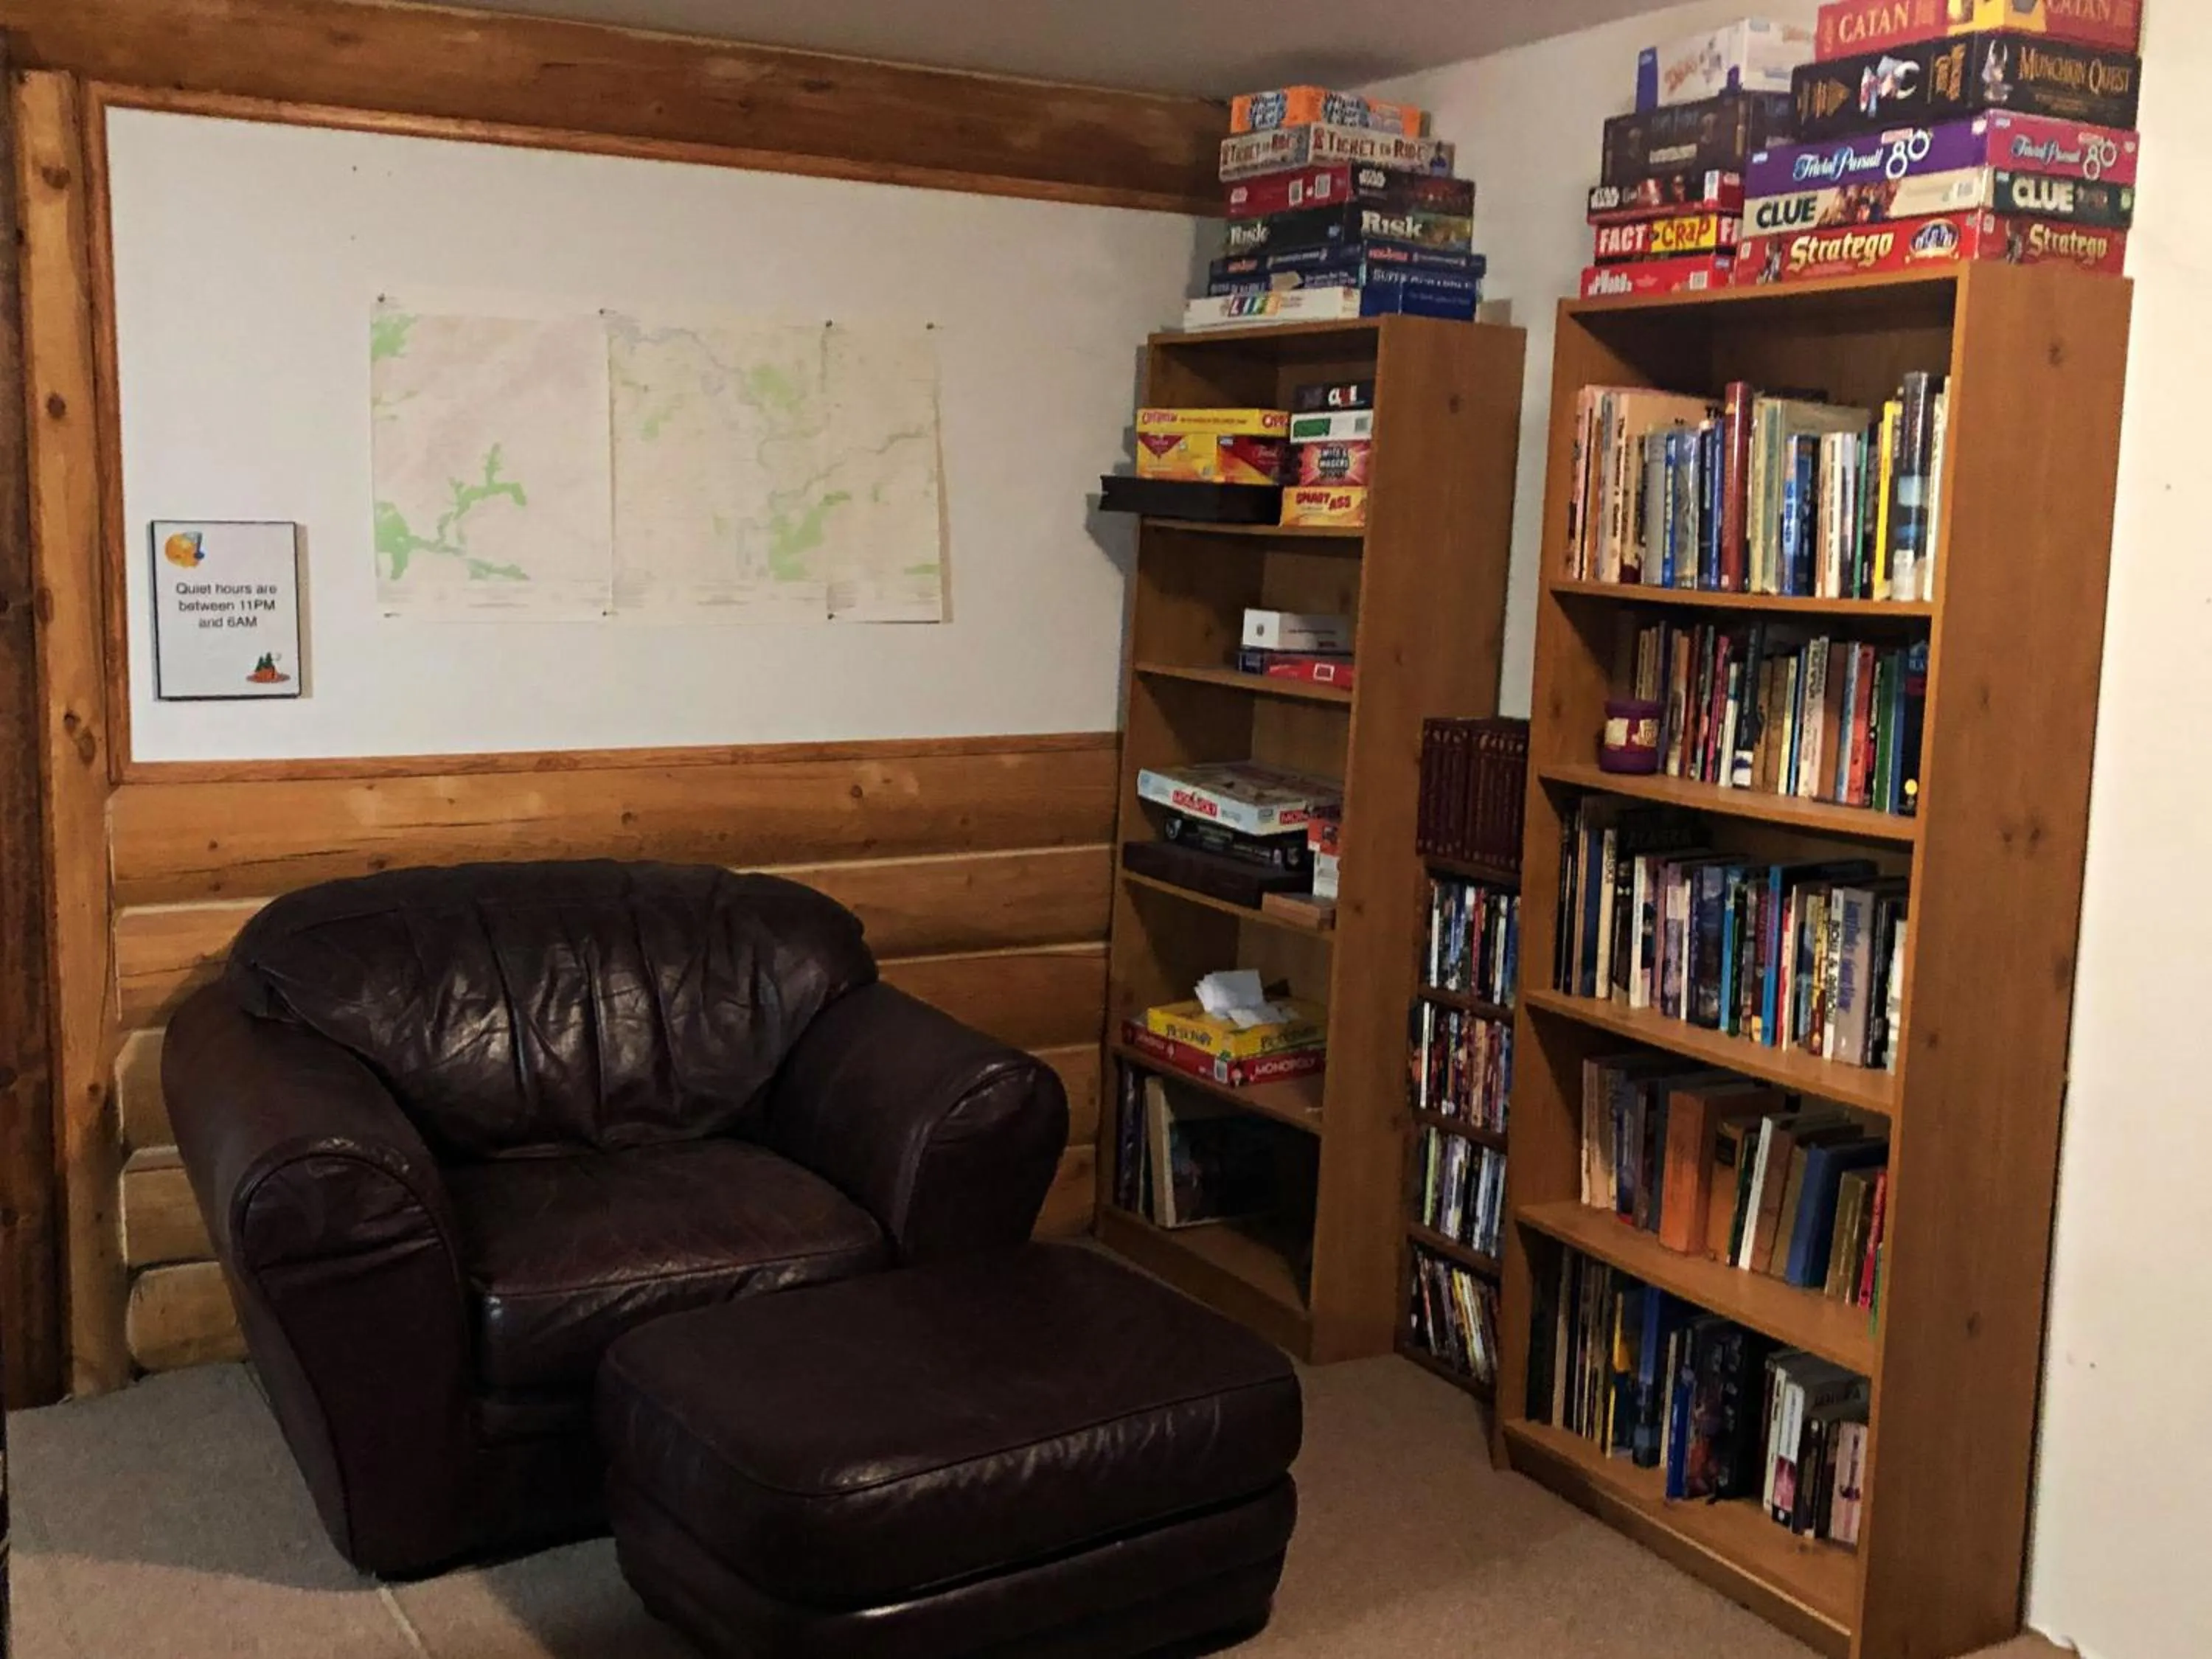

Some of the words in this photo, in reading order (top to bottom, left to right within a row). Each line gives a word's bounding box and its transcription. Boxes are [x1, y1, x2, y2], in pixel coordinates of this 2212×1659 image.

[1839, 1, 1910, 43] CATAN
[1792, 153, 1835, 181] Trivial
[2012, 176, 2074, 213] CLUE
[1756, 195, 1817, 228] CLUE
[1599, 223, 1647, 253] FACT
[1787, 232, 1894, 273] Stratego
[2026, 223, 2107, 265] Stratego
[175, 582, 212, 594] Quiet
[215, 582, 252, 594] hours
[256, 585, 278, 594] are
[178, 599, 234, 611] between
[240, 599, 275, 611] 11PM
[198, 616, 223, 629] and
[227, 615, 257, 628] 6AM
